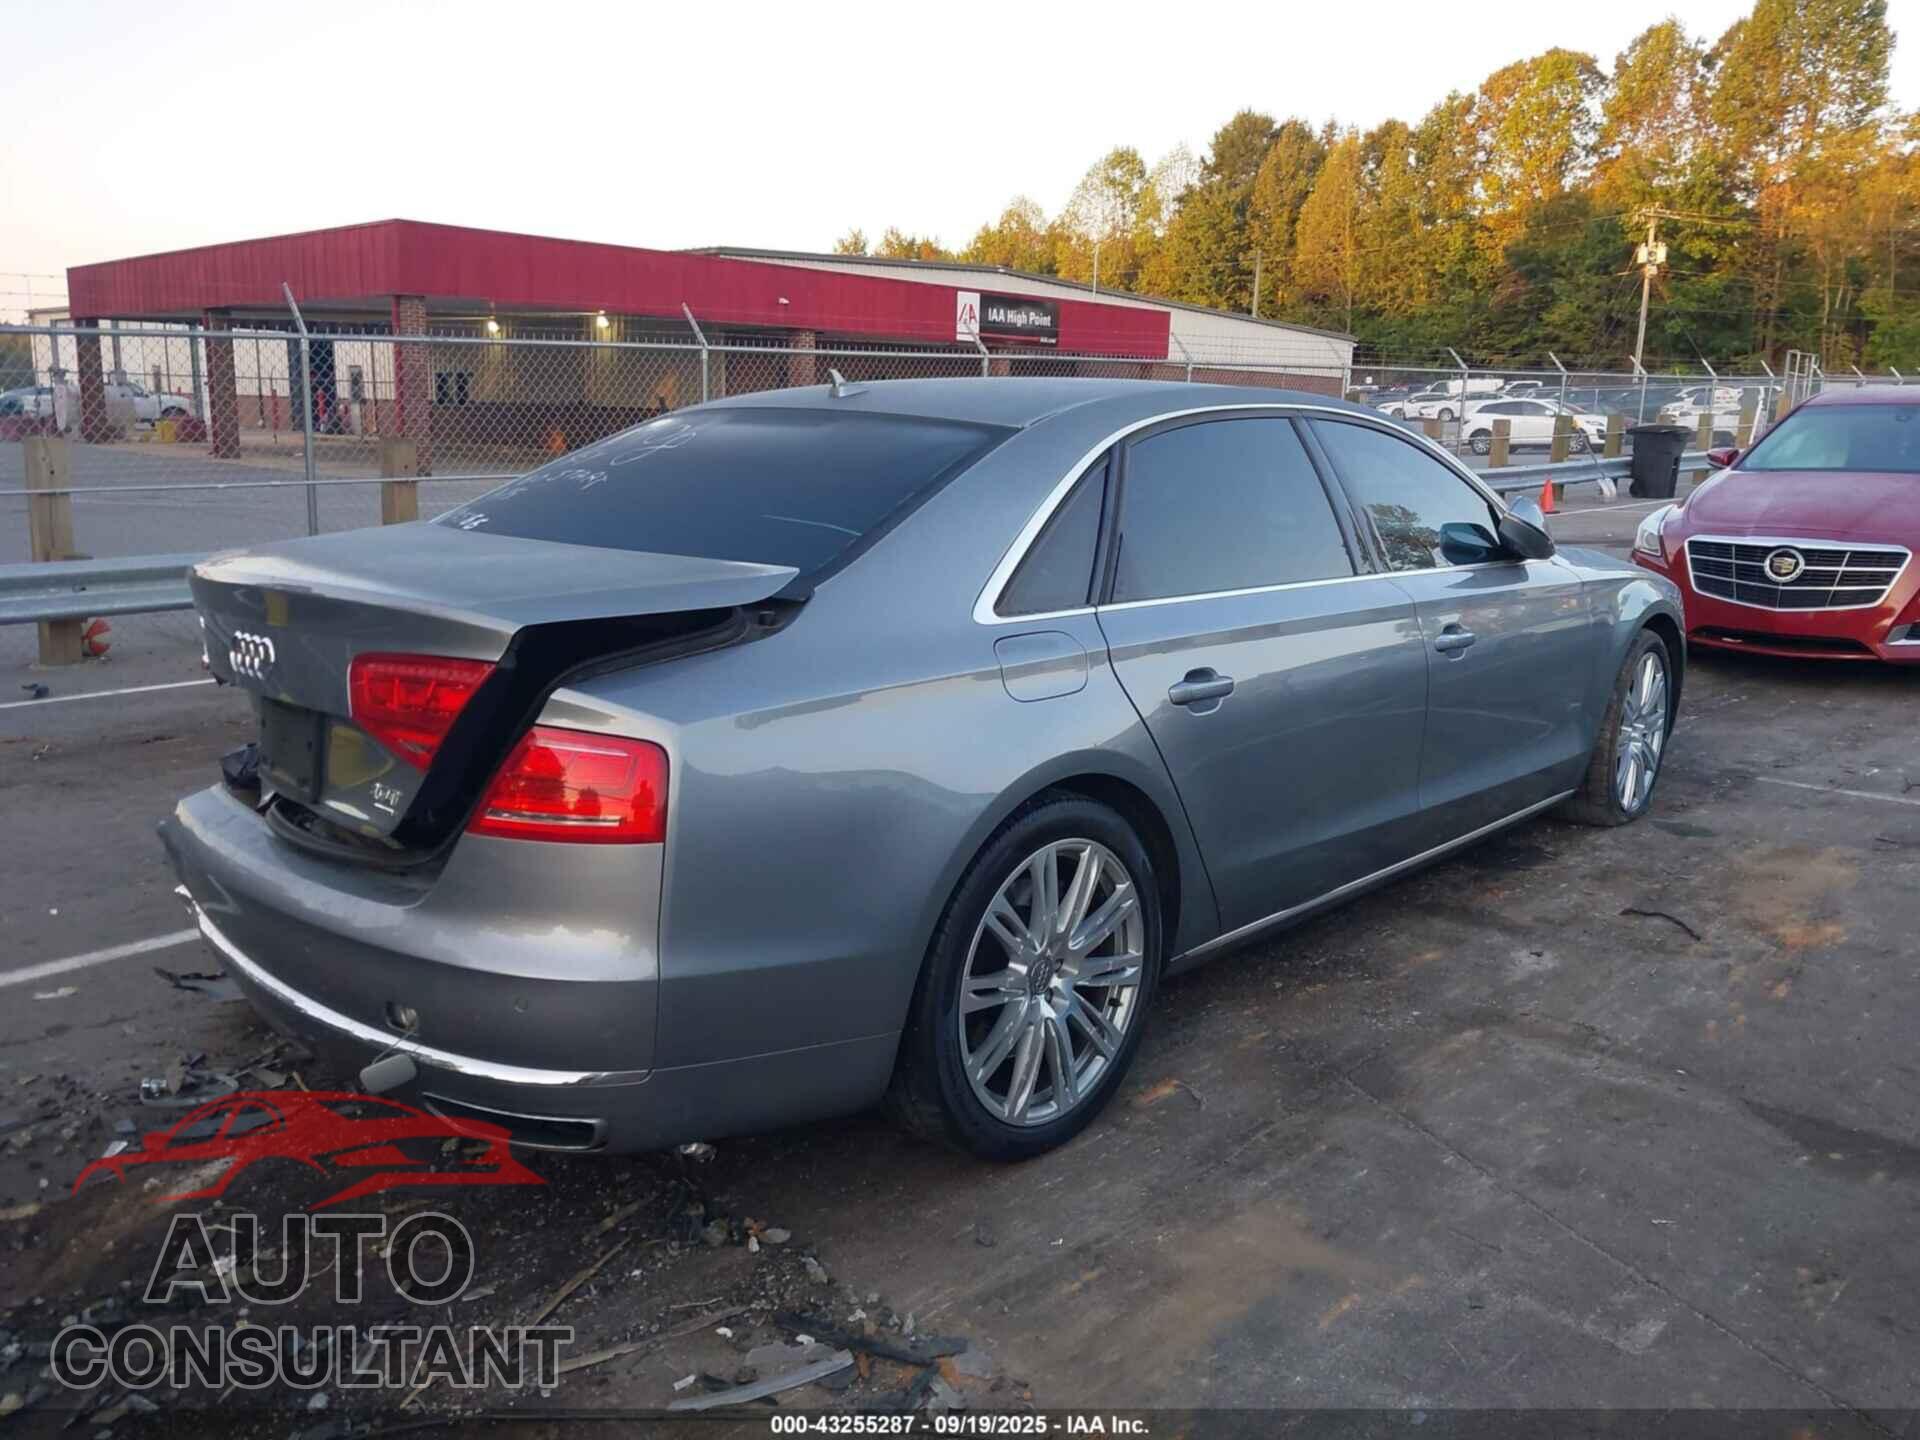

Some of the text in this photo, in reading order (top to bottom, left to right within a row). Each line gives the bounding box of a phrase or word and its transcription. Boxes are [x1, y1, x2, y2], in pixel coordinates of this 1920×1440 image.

[988, 307, 1051, 327] IAA High Point
